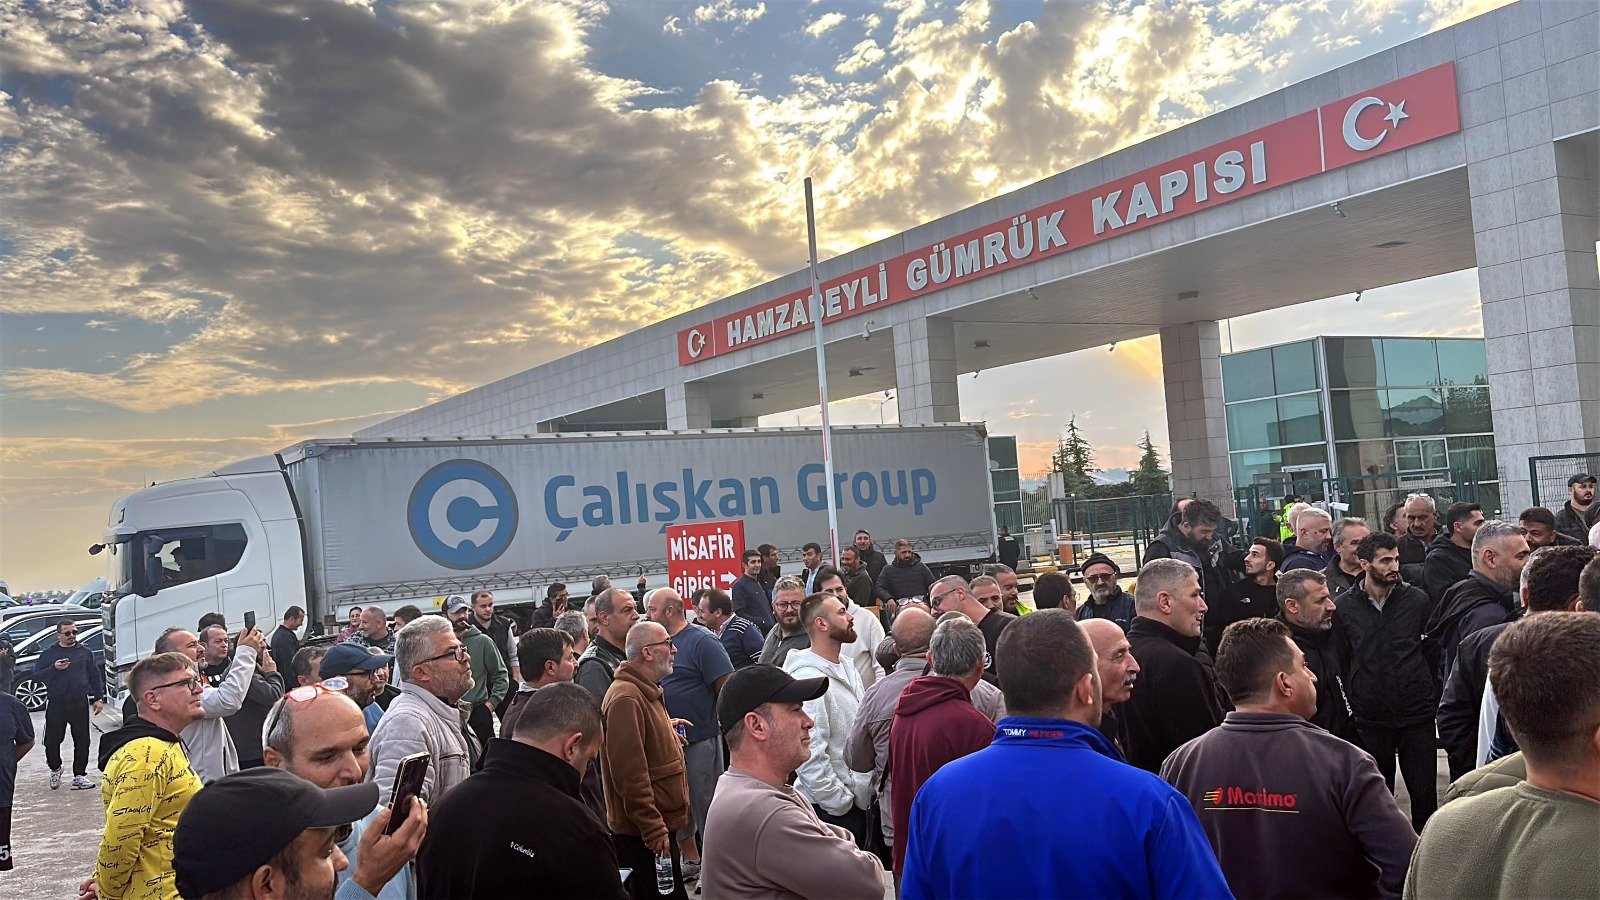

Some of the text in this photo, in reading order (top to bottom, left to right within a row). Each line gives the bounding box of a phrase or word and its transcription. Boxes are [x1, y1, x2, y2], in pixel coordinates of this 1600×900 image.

[727, 140, 1267, 347] HAMZABEYLİ GÜMRÜK KAPISI
[544, 463, 937, 542] Çalışkan Group
[670, 527, 736, 561] MİSAFİR
[1003, 728, 1026, 737] TOMMY
